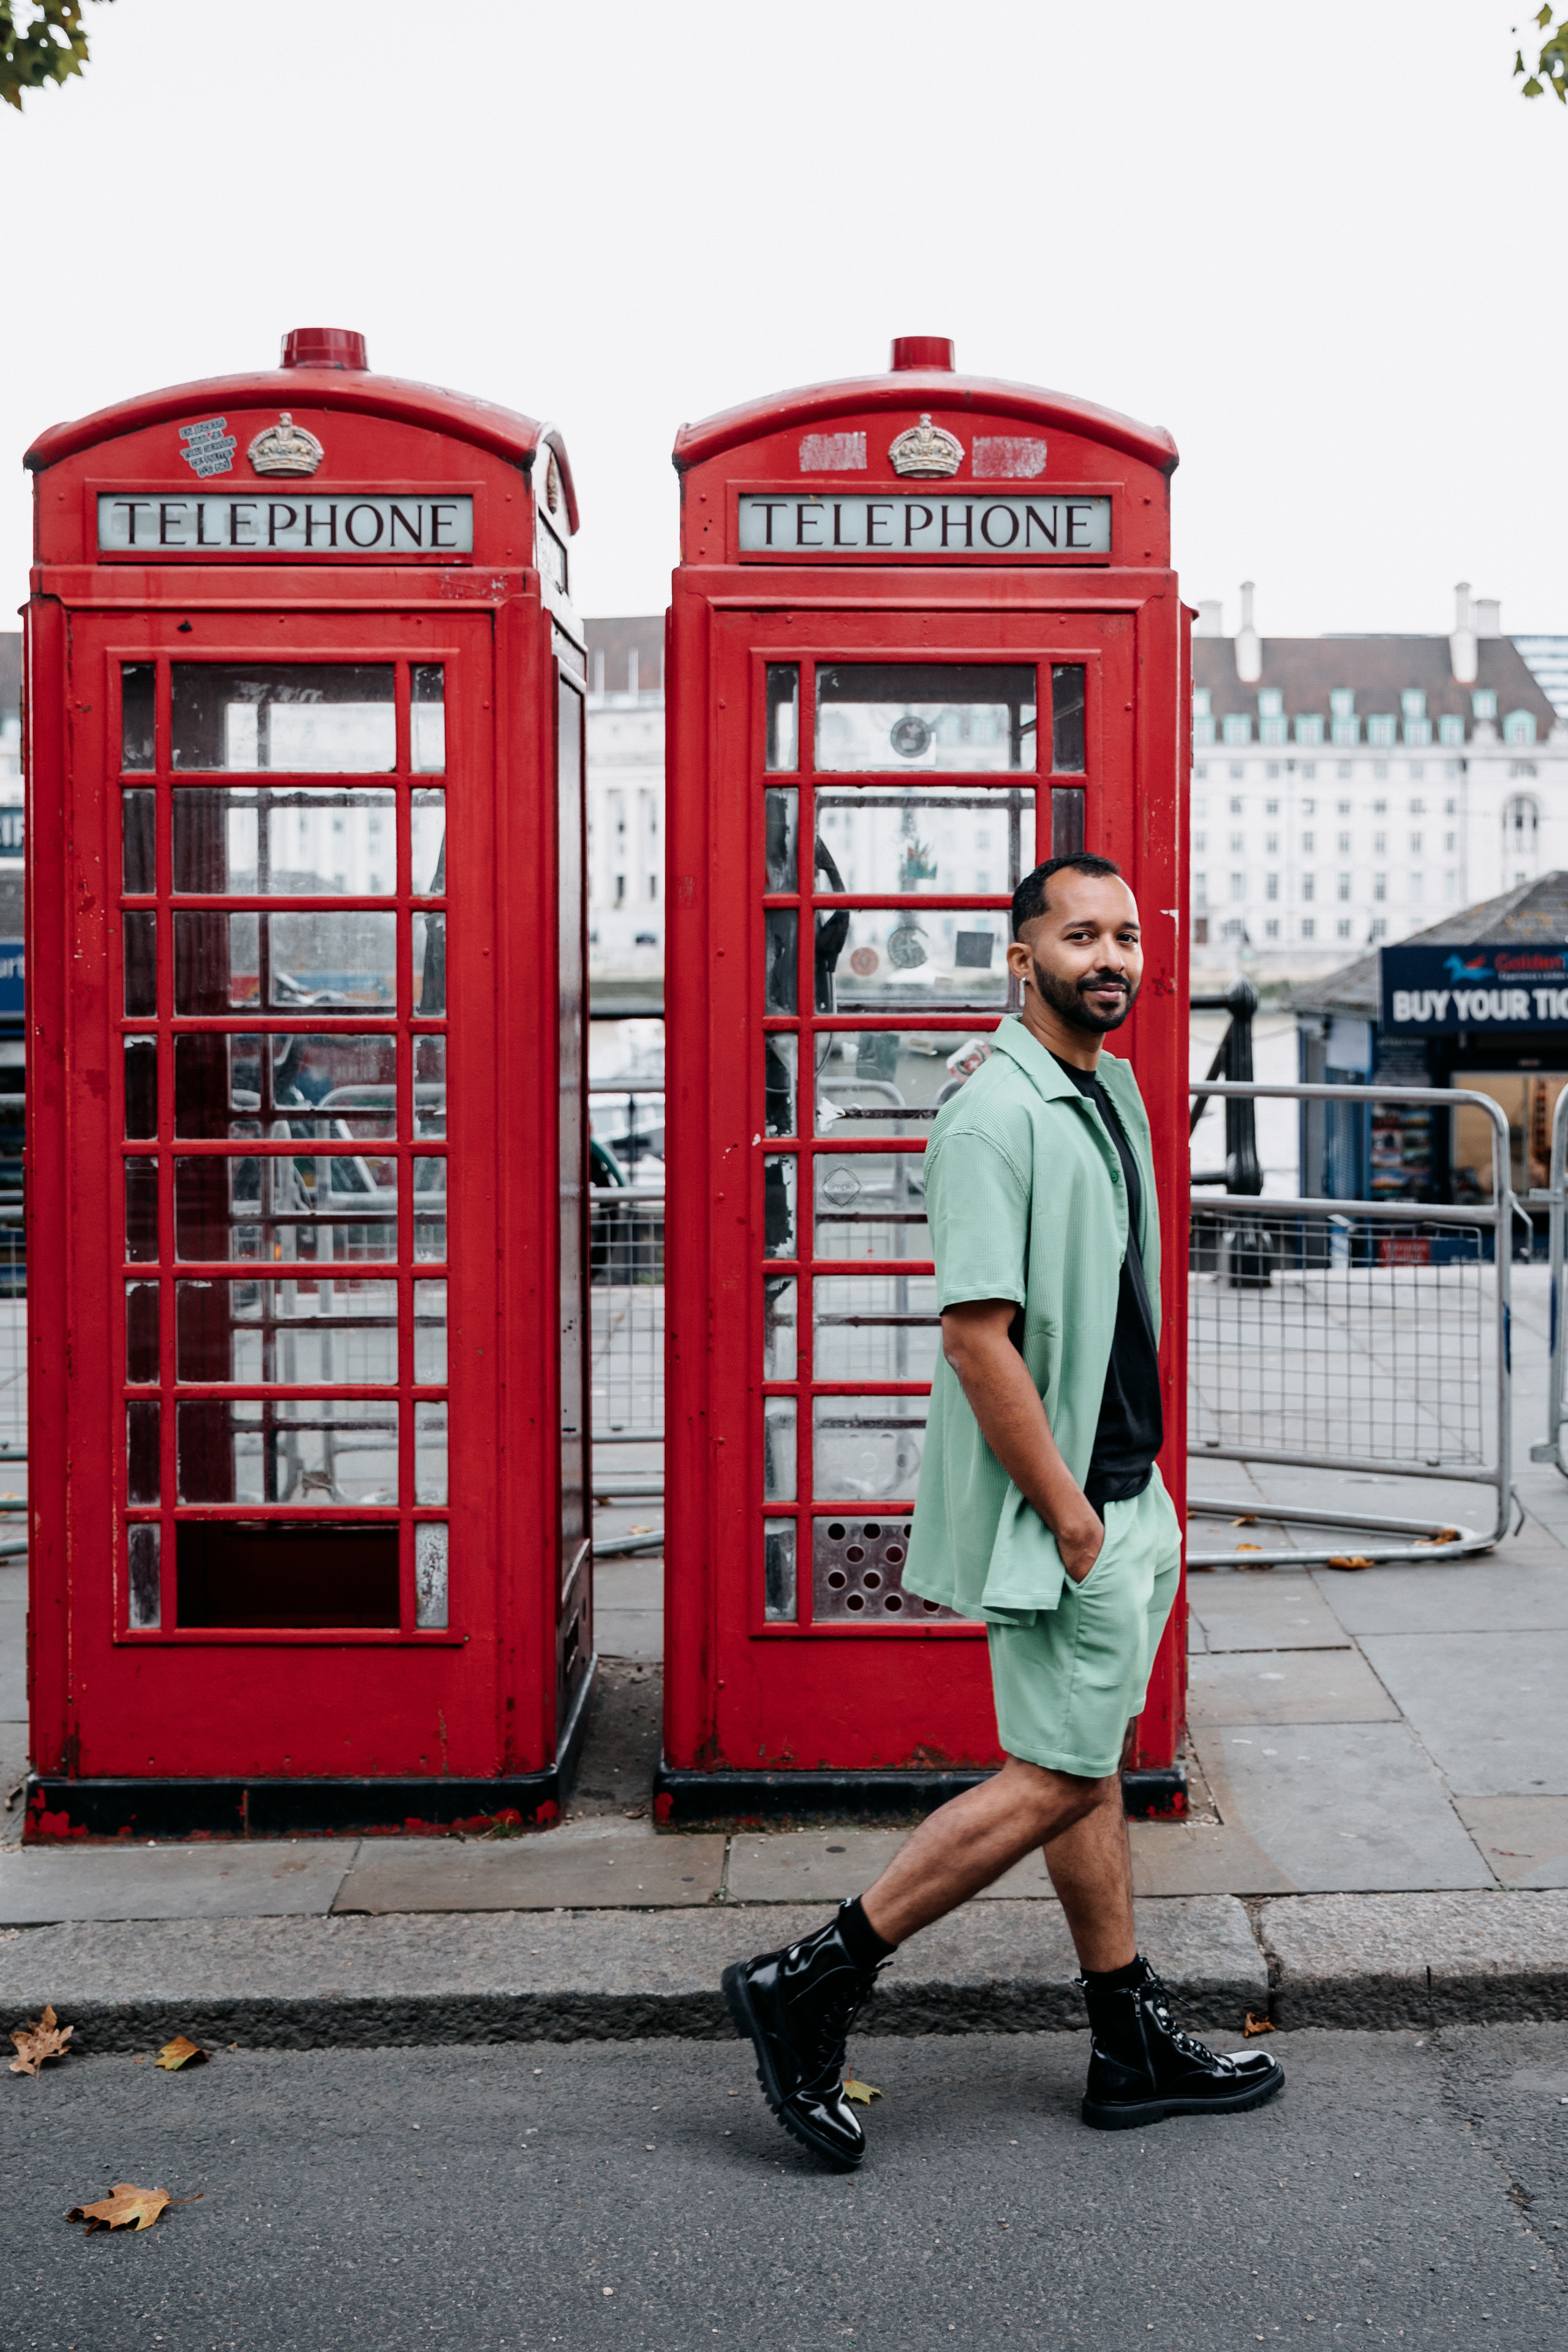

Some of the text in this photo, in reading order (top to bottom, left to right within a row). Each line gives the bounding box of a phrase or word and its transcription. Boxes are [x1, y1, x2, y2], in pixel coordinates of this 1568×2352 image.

[113, 502, 458, 547] TELEPHONE
[751, 503, 1093, 548] TELEPHONE
[1393, 989, 1451, 1022] BUY
[1452, 989, 1530, 1022] YOUR
